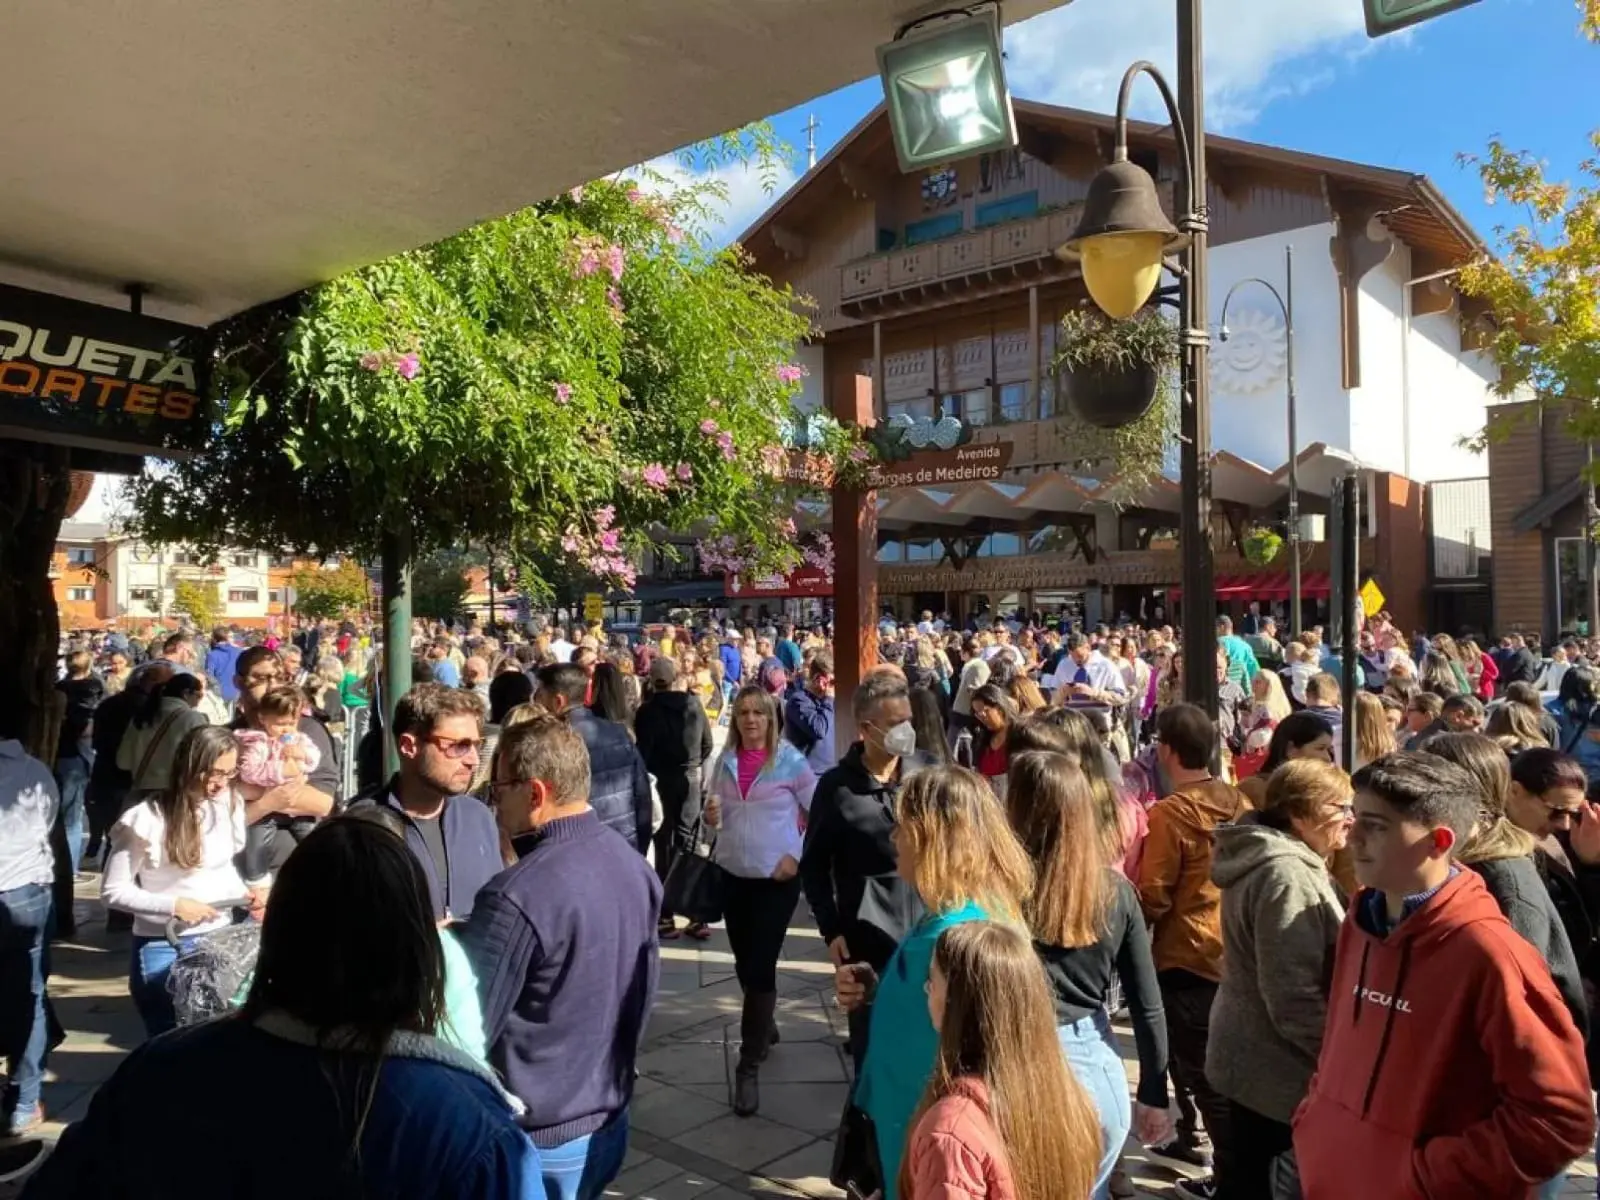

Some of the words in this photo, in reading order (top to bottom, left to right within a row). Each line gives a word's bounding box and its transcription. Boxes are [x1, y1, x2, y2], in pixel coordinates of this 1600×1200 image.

[0, 361, 197, 420] ORTES
[957, 446, 1001, 461] Avenida
[916, 468, 932, 483] de
[935, 463, 999, 482] Medeiros
